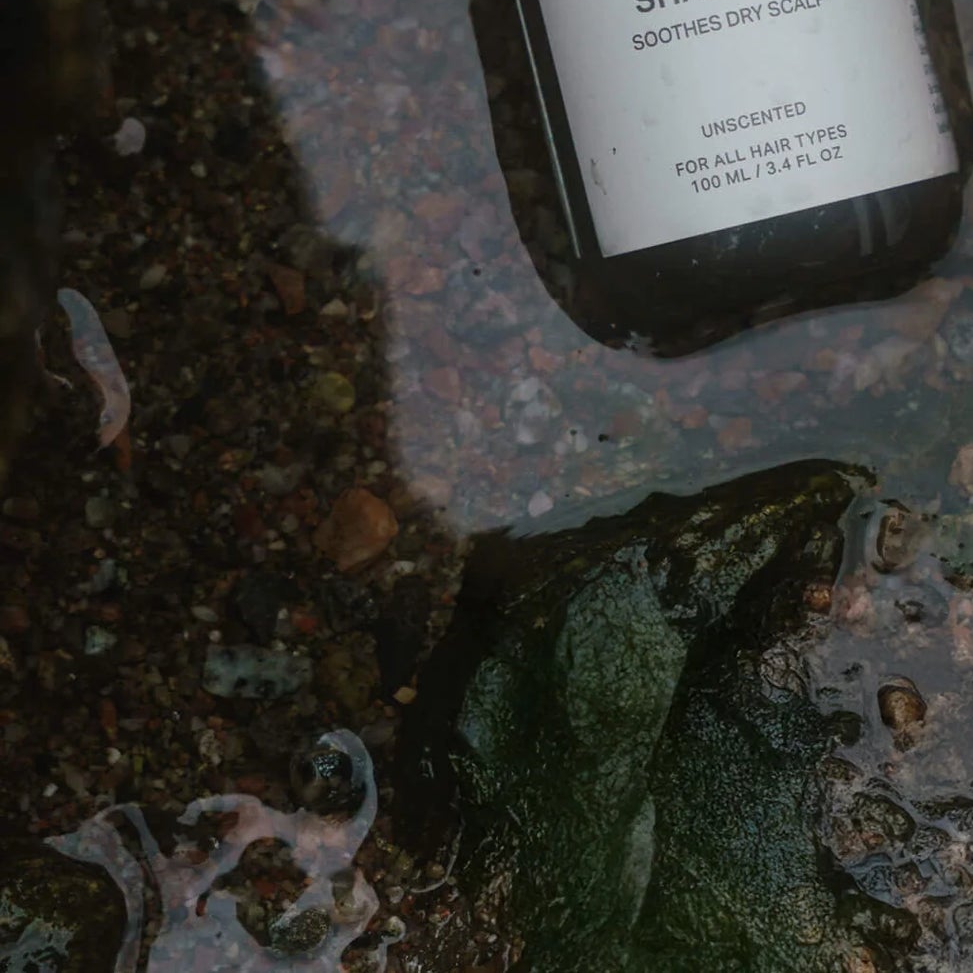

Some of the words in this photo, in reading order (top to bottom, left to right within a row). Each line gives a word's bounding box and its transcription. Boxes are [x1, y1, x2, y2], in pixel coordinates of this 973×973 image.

[631, 15, 722, 50] SOOTHES
[726, 4, 763, 28] DRY
[701, 101, 806, 138] UNSCENTED
[675, 157, 709, 176] FOR
[714, 149, 746, 167] ALL
[750, 137, 791, 158] HAIR
[794, 124, 847, 147] TYPES
[691, 175, 721, 193] 100
[725, 168, 751, 185] ML
[755, 164, 760, 178] /
[767, 157, 792, 175] 3.4
[796, 153, 816, 168] FL
[820, 146, 843, 161] OZ
